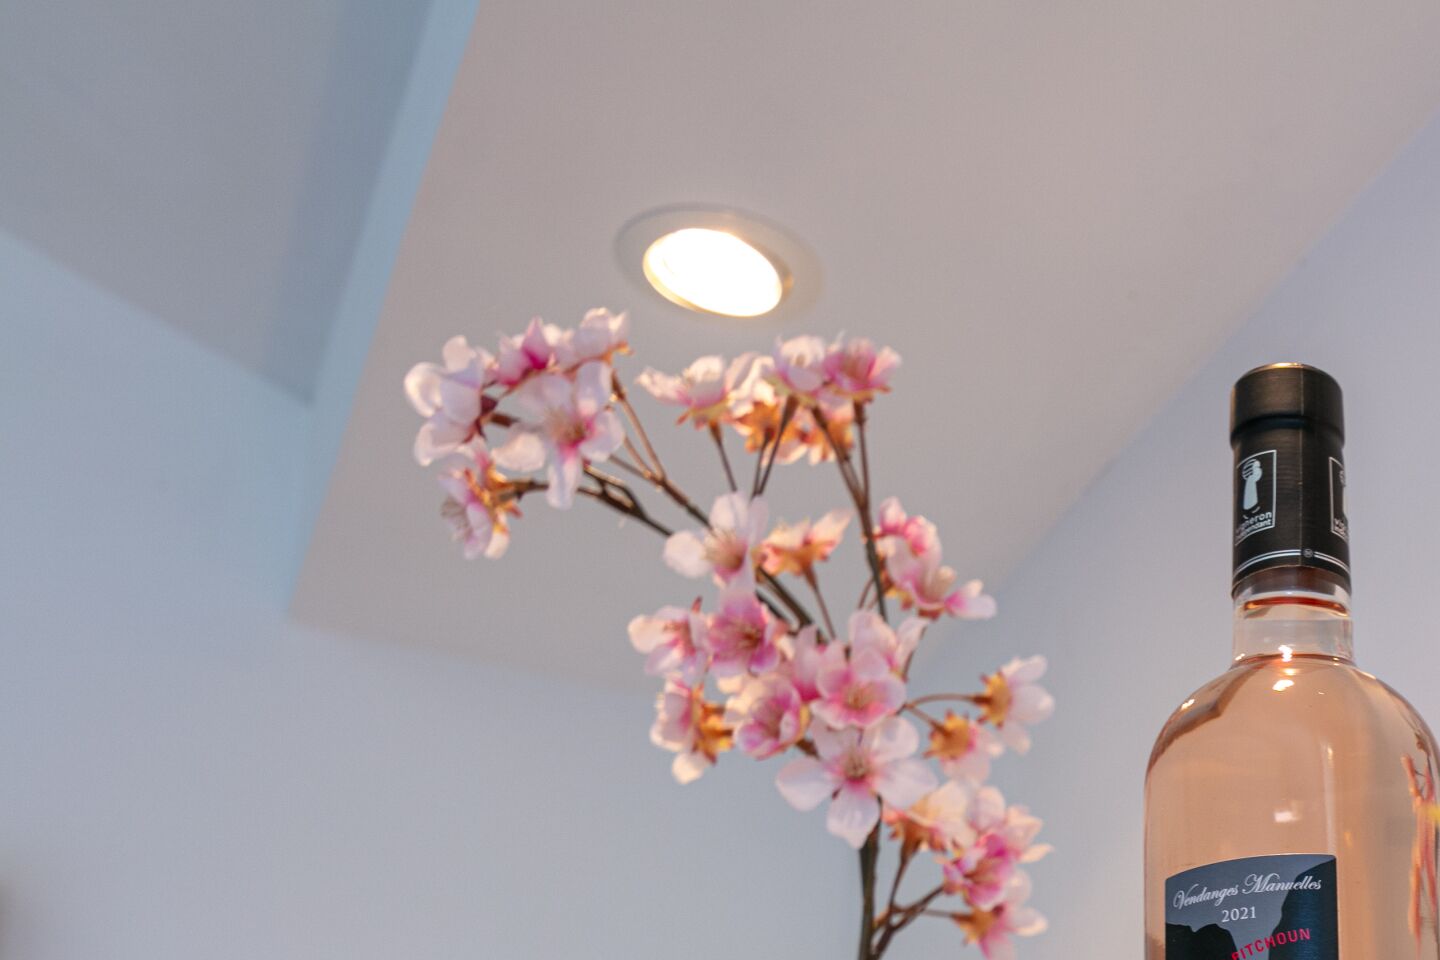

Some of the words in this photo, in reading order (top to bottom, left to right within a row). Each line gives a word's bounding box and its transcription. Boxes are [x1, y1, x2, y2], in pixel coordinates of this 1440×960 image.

[1173, 883, 1239, 910] Vendanges
[1242, 873, 1322, 894] Manuelles
[1221, 906, 1257, 923] 2021
